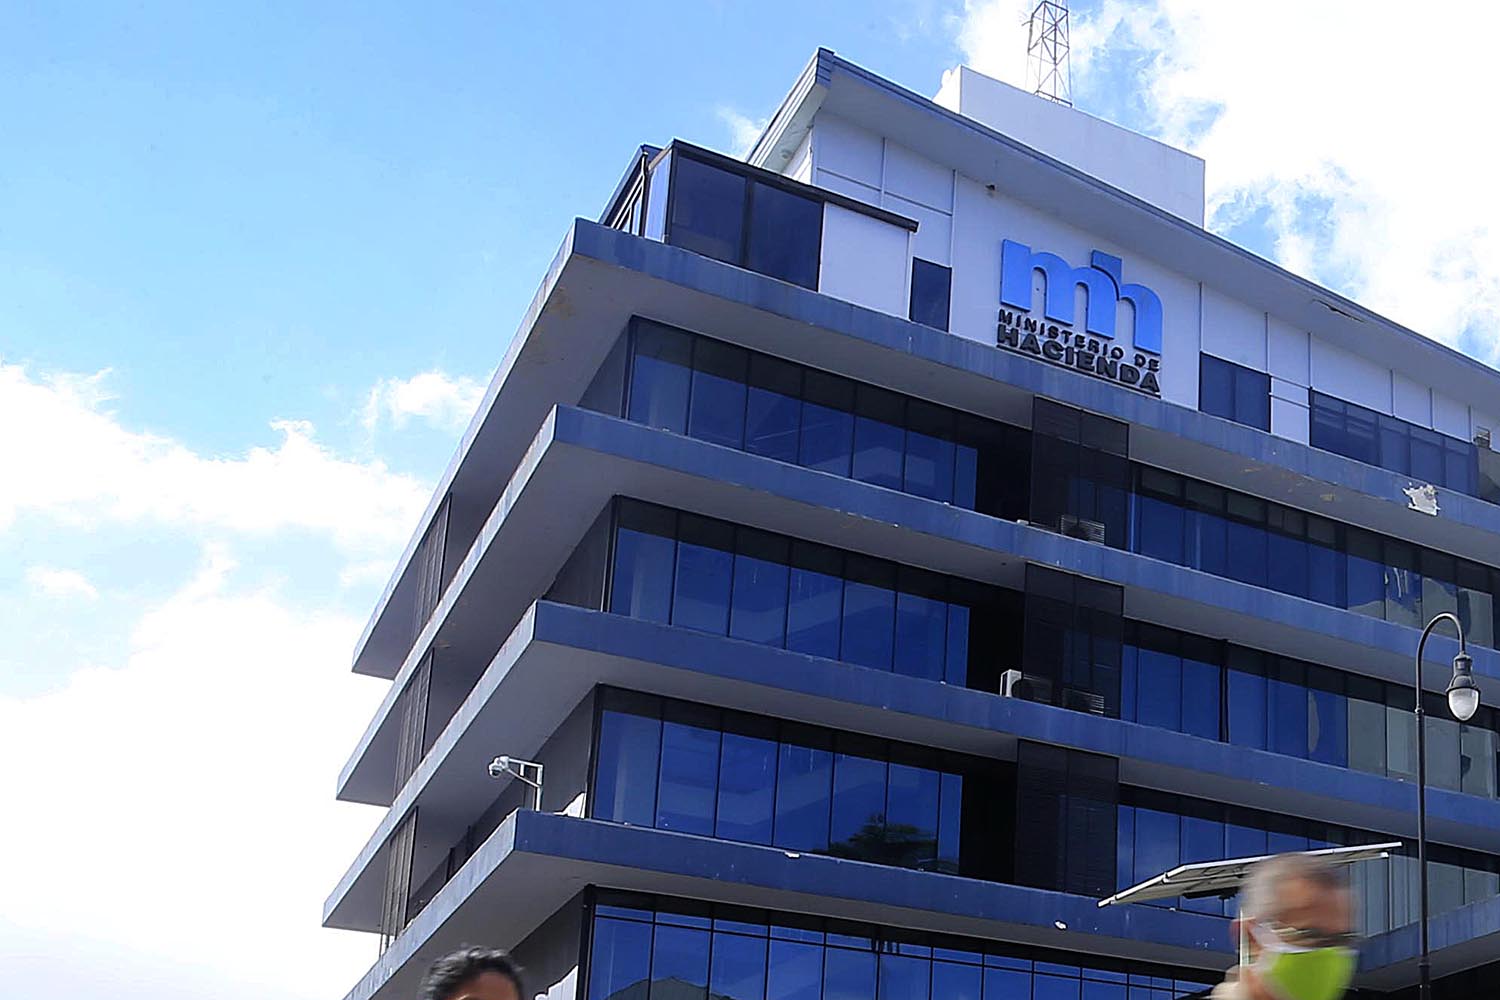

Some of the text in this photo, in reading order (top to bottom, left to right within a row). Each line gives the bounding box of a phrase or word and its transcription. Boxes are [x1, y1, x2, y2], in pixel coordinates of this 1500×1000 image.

[997, 324, 1161, 393] HACIENDA
[998, 309, 1160, 372] MINISTERIO DE
